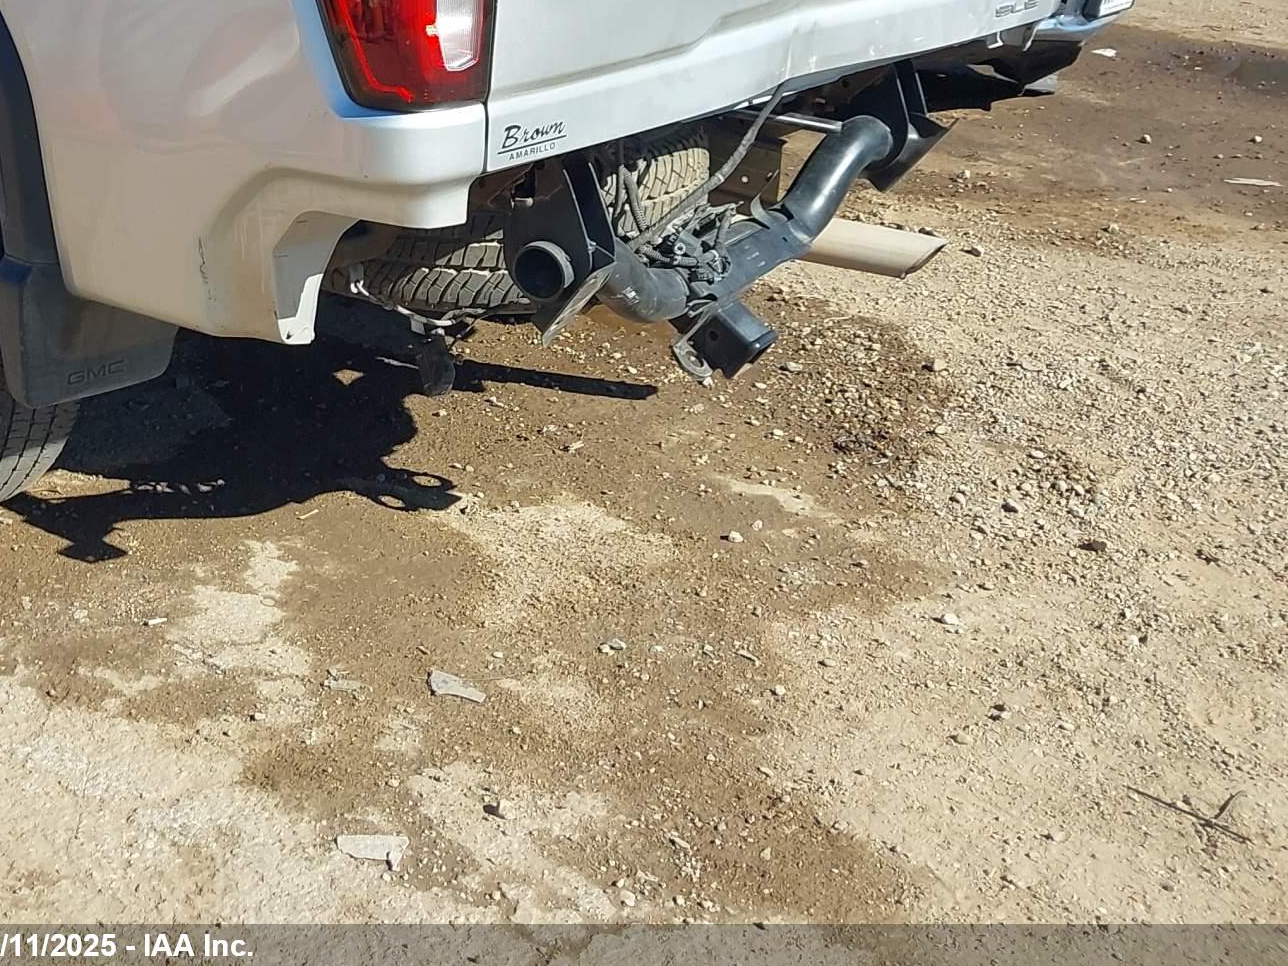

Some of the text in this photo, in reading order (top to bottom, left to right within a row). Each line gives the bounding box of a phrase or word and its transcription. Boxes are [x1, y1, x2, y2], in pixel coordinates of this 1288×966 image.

[502, 121, 566, 150] Brown
[508, 142, 556, 161] AMARILLO
[66, 358, 126, 386] GMC
